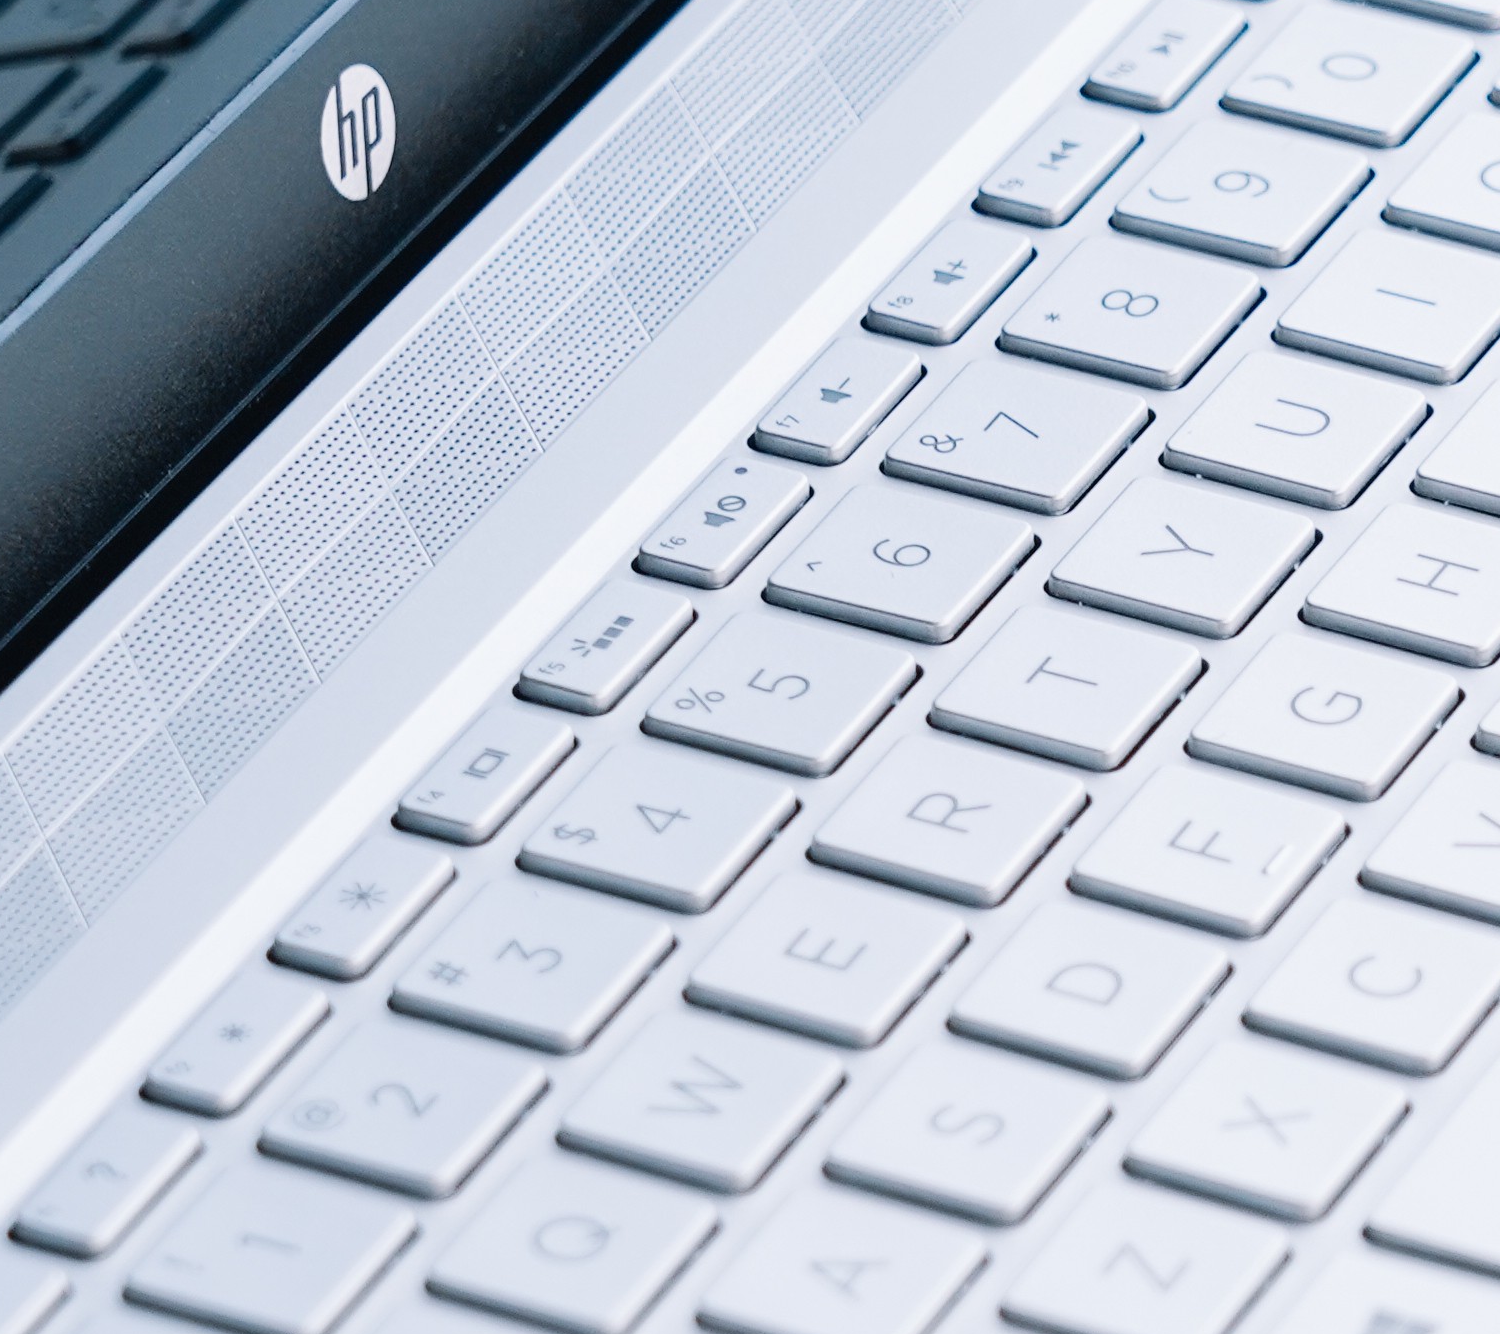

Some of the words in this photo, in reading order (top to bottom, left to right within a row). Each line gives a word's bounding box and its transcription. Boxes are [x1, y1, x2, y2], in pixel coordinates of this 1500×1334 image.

[328, 65, 390, 199] hp
[1214, 170, 1270, 198] 9
[1101, 288, 1159, 318] 8
[774, 414, 801, 429] f7
[920, 431, 964, 456] &
[983, 410, 1040, 440] 7
[1254, 398, 1331, 438] U
[659, 535, 687, 552] f6
[873, 537, 931, 568] 6
[1140, 522, 1215, 562] Y
[1396, 552, 1480, 598] H
[536, 661, 567, 679] f5
[675, 687, 725, 714] %
[747, 667, 811, 701] 5
[1024, 655, 1099, 689] T
[1290, 685, 1366, 727] G
[553, 821, 598, 847] $
[635, 802, 692, 835] 4
[906, 791, 992, 833] R
[1167, 817, 1234, 865] F
[427, 959, 469, 987] #
[497, 938, 563, 975] 3
[784, 927, 869, 972] E
[1044, 959, 1124, 1007] D
[1347, 952, 1425, 1001] C
[291, 1097, 346, 1133] @
[368, 1082, 442, 1119] 2
[648, 1056, 746, 1120] W
[930, 1104, 1006, 1145] S
[1220, 1095, 1315, 1147] X
[533, 1216, 612, 1261] Q
[811, 1255, 889, 1301] A
[1102, 1241, 1193, 1292] Z
